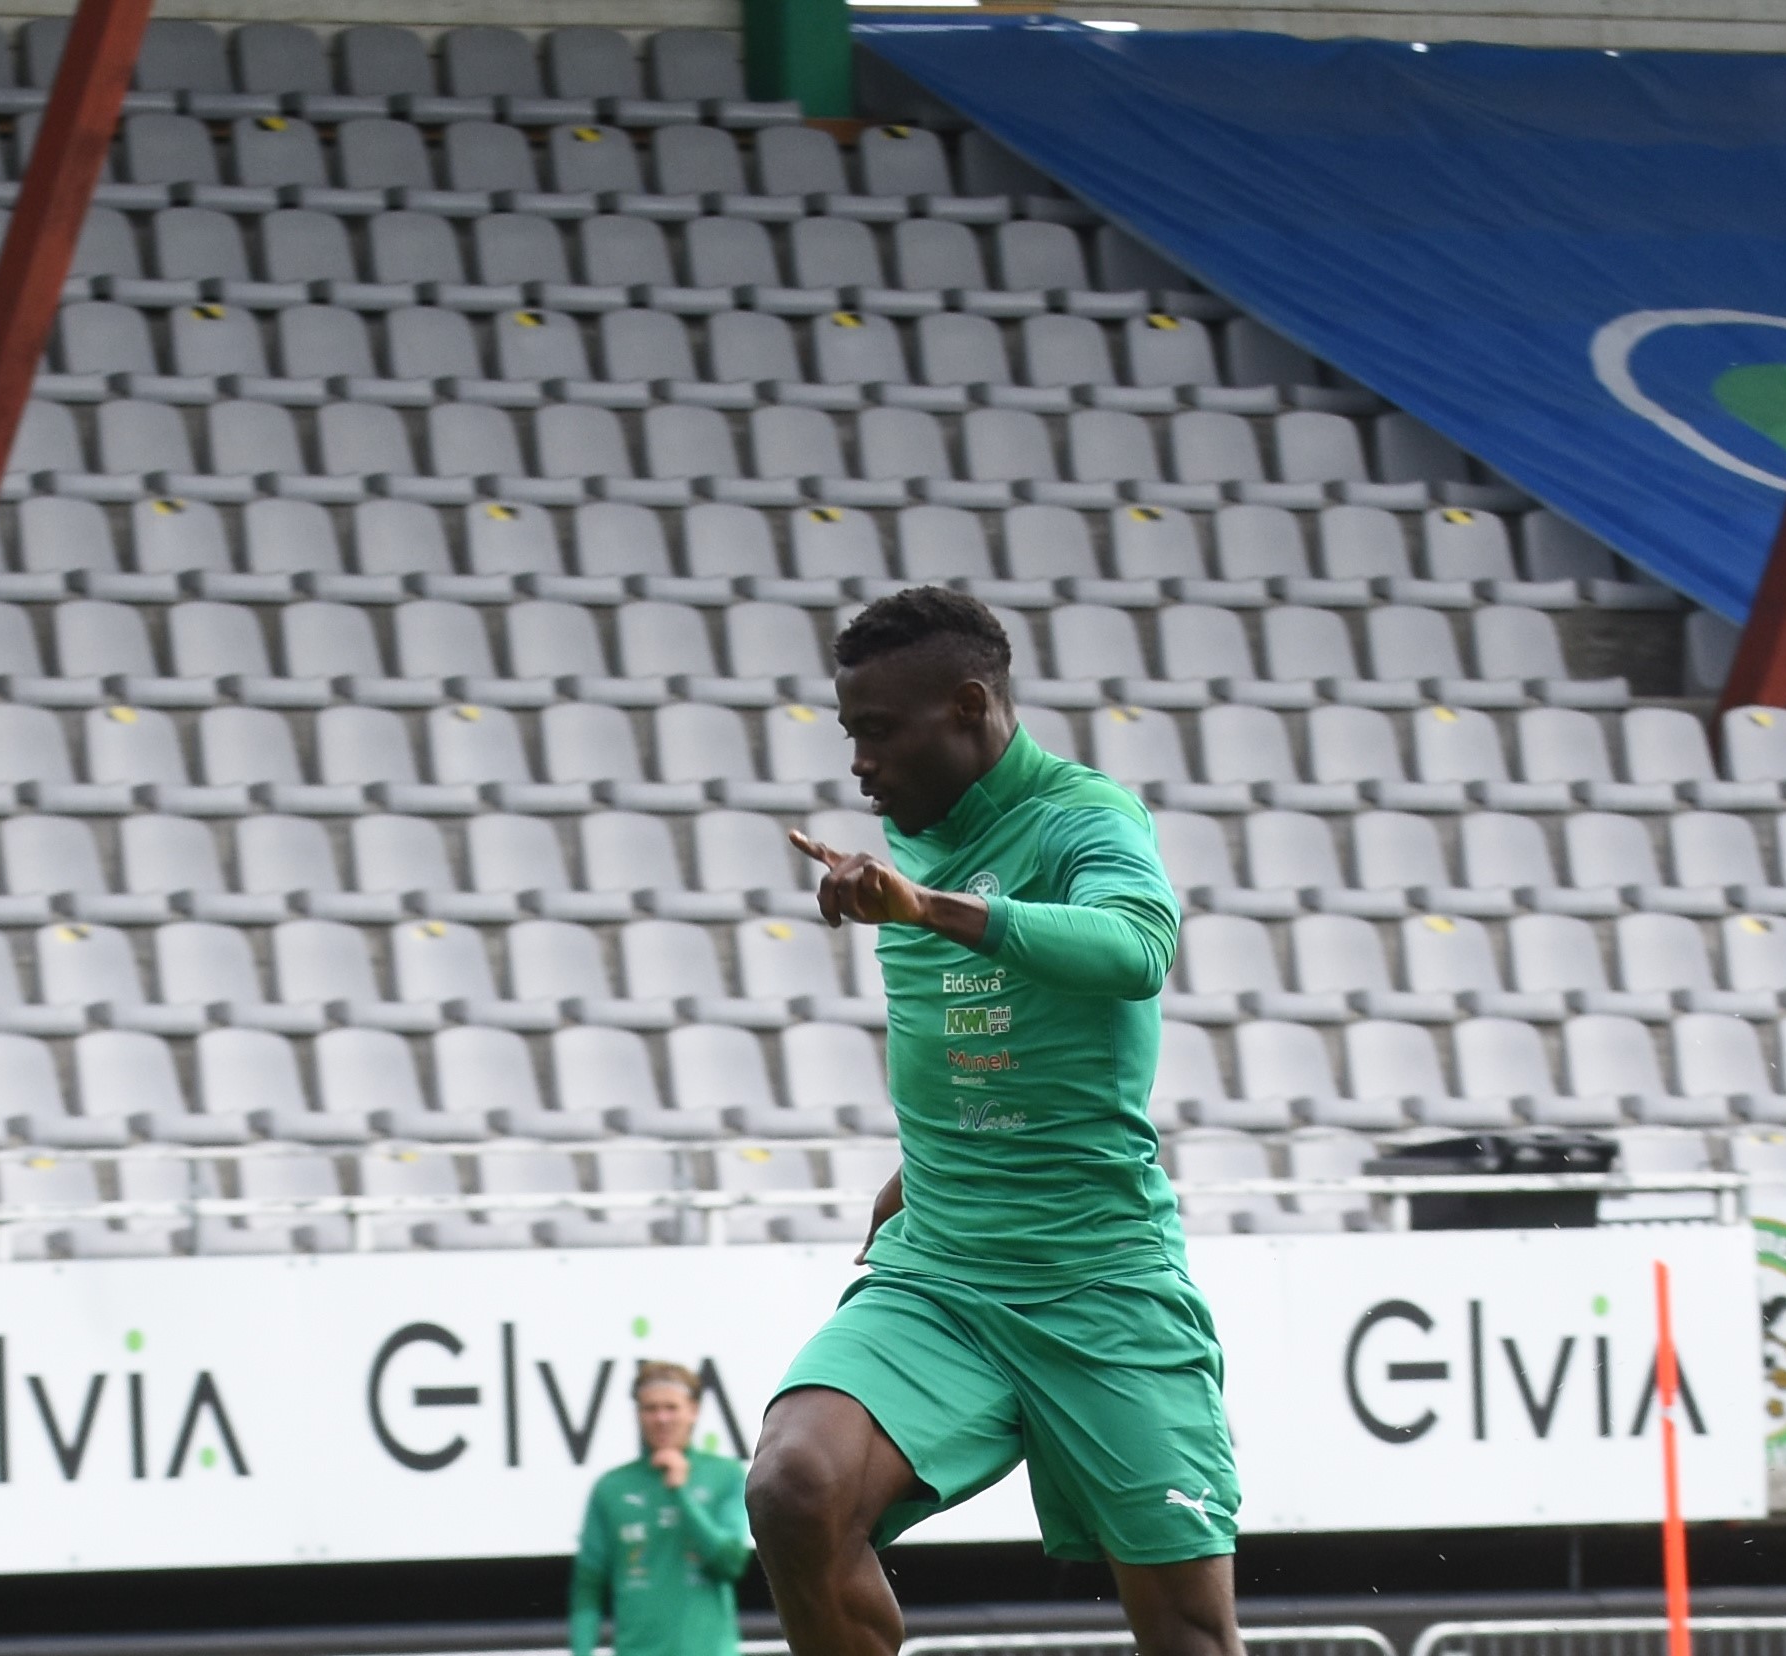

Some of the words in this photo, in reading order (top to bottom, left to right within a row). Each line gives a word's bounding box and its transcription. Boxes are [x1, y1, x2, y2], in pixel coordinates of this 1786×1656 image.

[942, 970, 1003, 993] Eidsiva
[946, 1008, 987, 1034] KIWI
[988, 1008, 1011, 1020] mini
